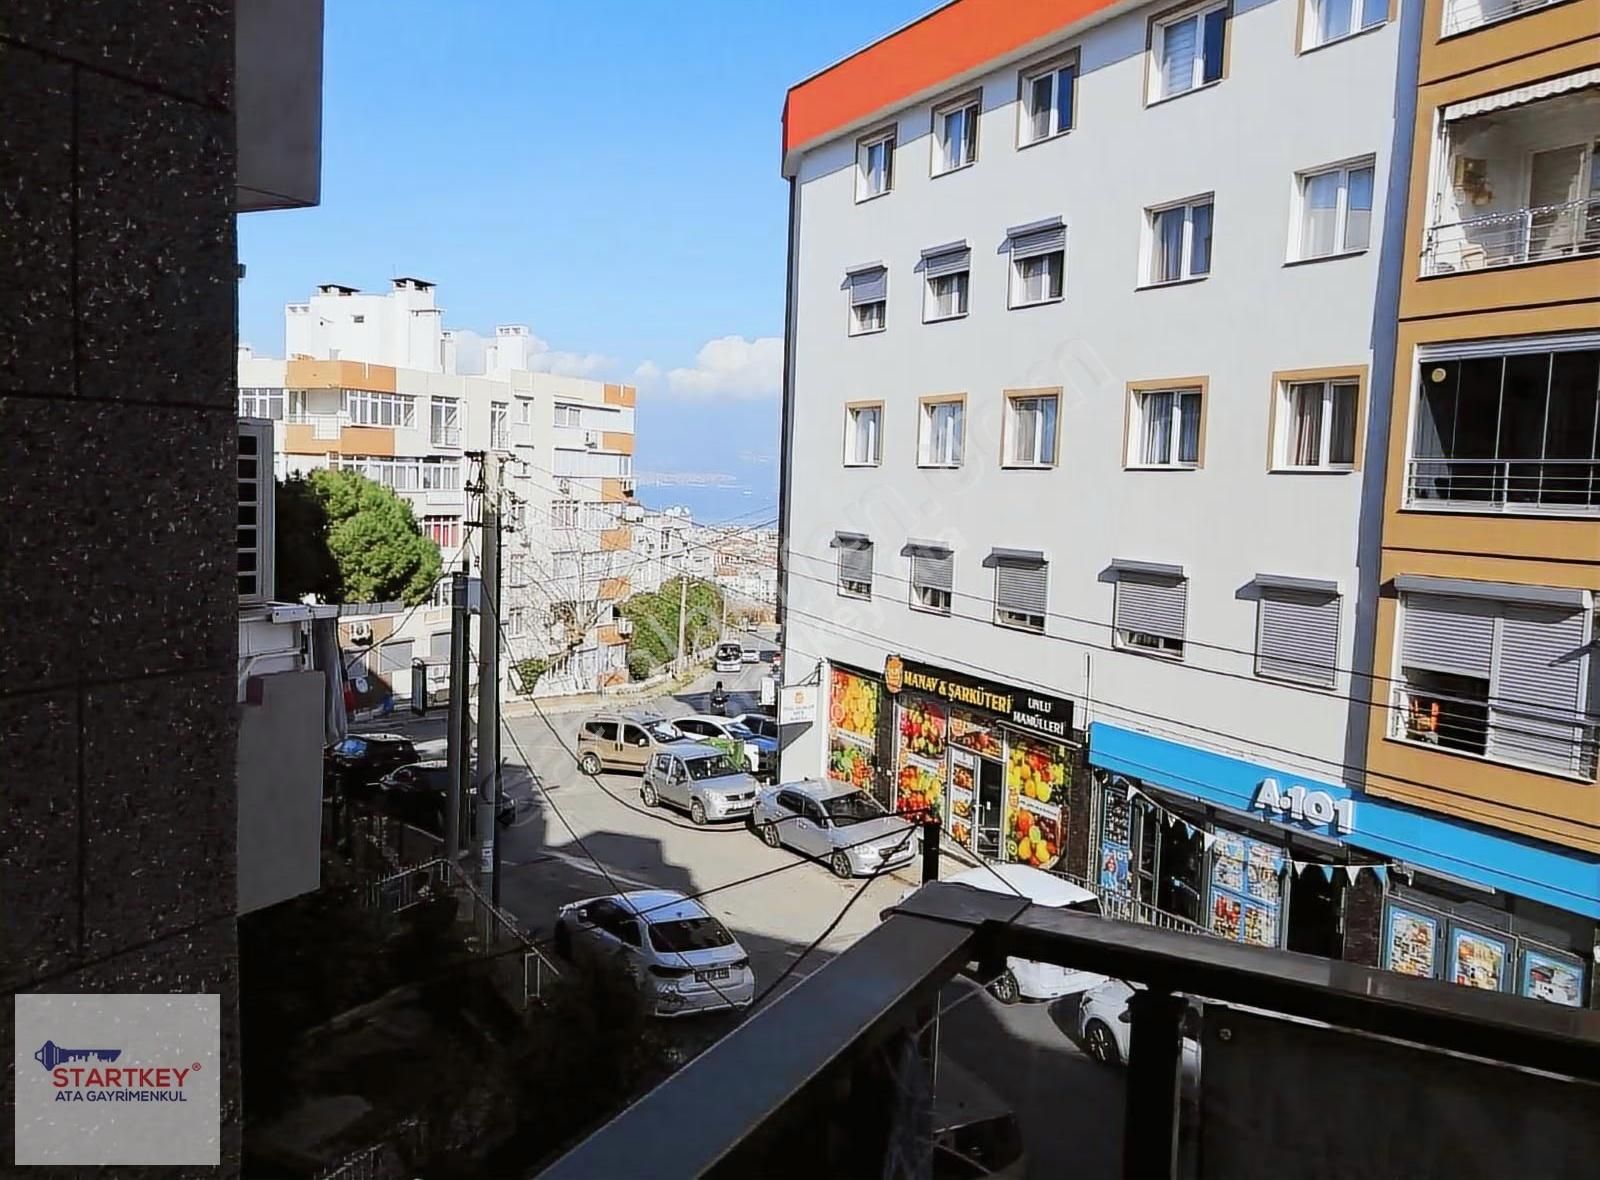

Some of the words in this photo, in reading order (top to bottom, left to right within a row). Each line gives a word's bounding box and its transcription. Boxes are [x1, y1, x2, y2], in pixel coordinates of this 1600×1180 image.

[904, 671, 938, 692] MANAY
[938, 681, 947, 696] &
[947, 683, 1013, 714] ŞARKÜTERİ
[1027, 697, 1052, 713] UNLU
